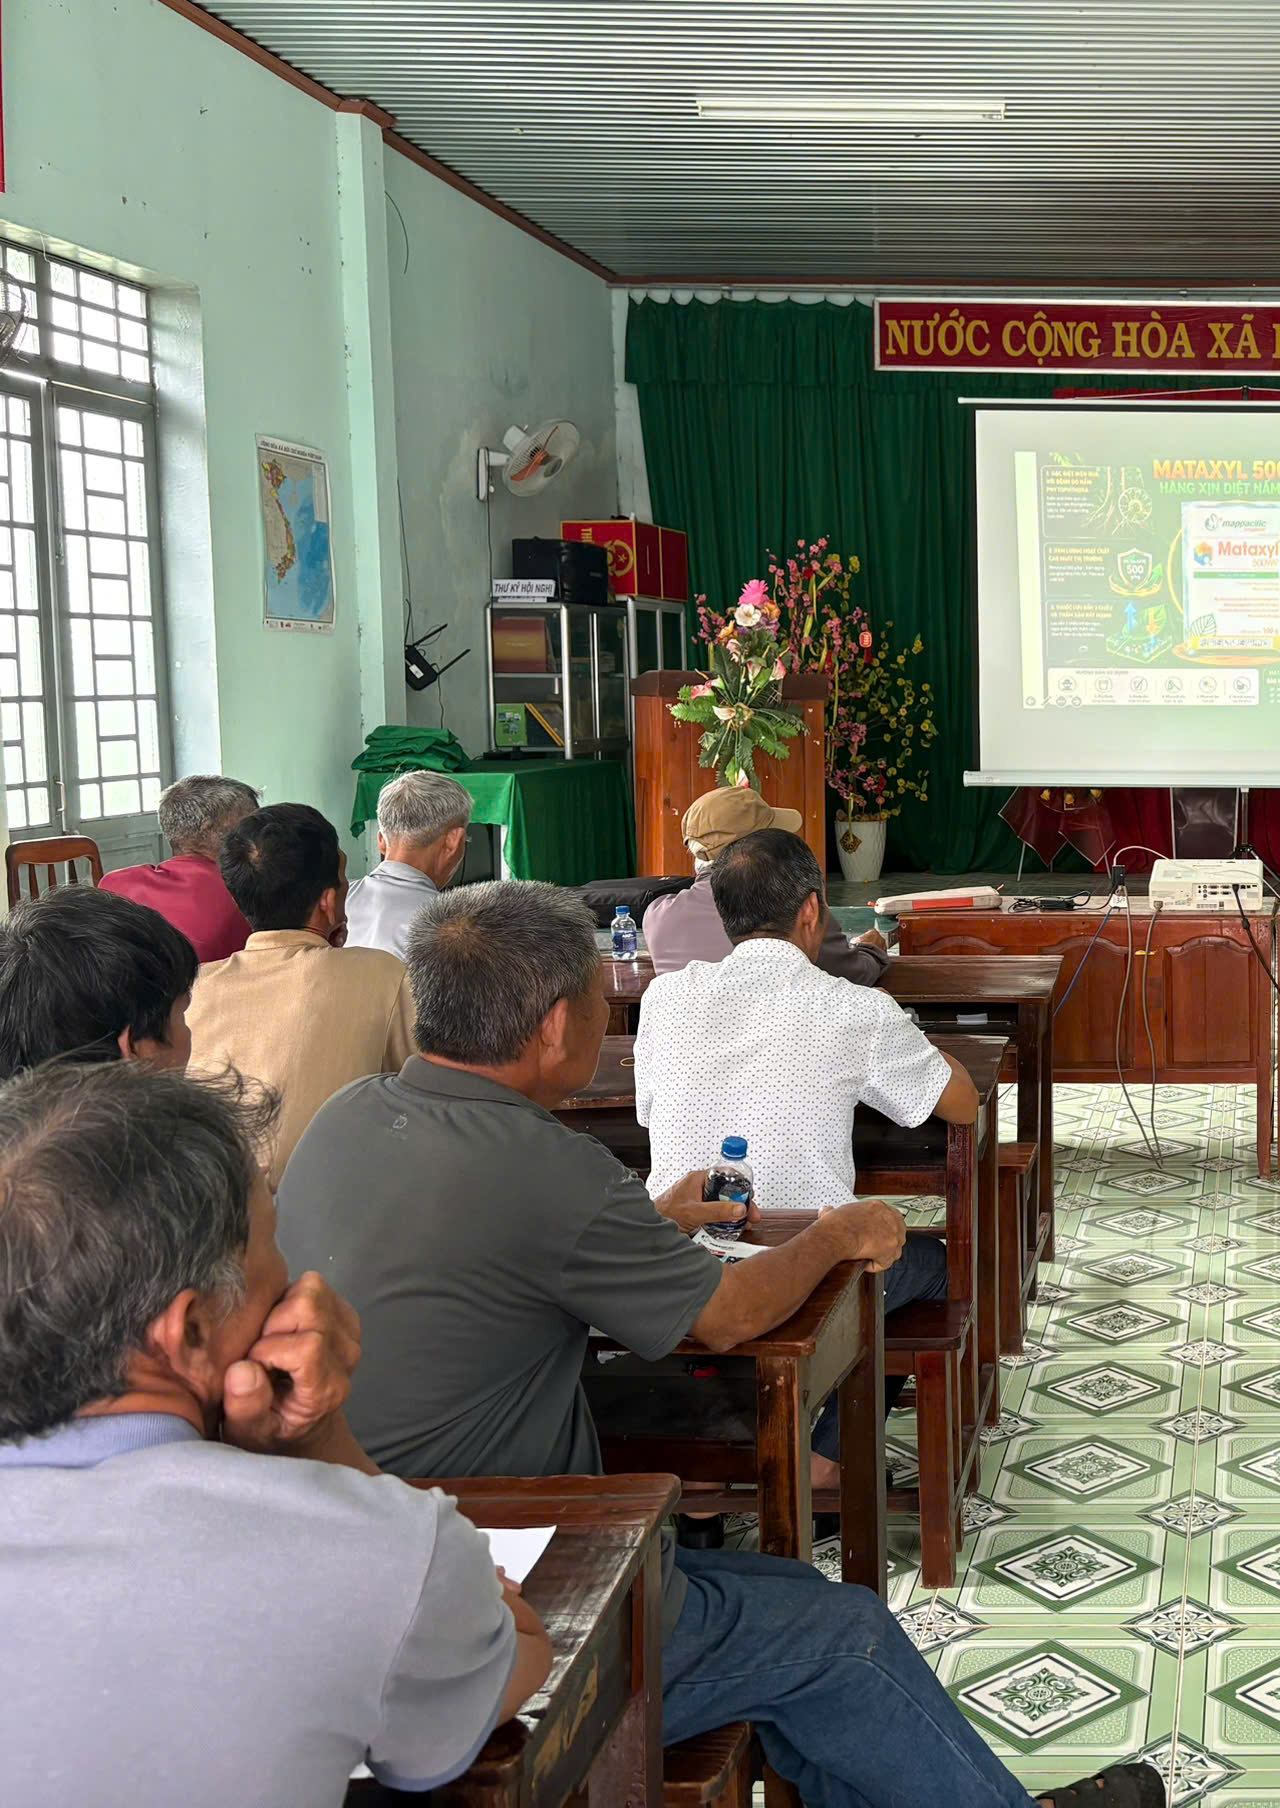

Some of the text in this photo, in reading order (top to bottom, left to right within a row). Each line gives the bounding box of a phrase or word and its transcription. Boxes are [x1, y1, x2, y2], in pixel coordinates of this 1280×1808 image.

[886, 309, 990, 356] NƯỚC
[1002, 311, 1101, 365] CỘNG
[1112, 311, 1195, 358] HÒA
[1207, 314, 1261, 359] XÃ
[1153, 459, 1248, 480] MATAXYL
[1160, 480, 1195, 494] HÀNG
[1224, 480, 1251, 496] DIỆT
[1218, 541, 1280, 559] Mataxyl
[1127, 565, 1144, 574] 500
[495, 582, 510, 593] THƯ
[521, 581, 534, 594] HỘI
[535, 583, 554, 595] NGHỊ
